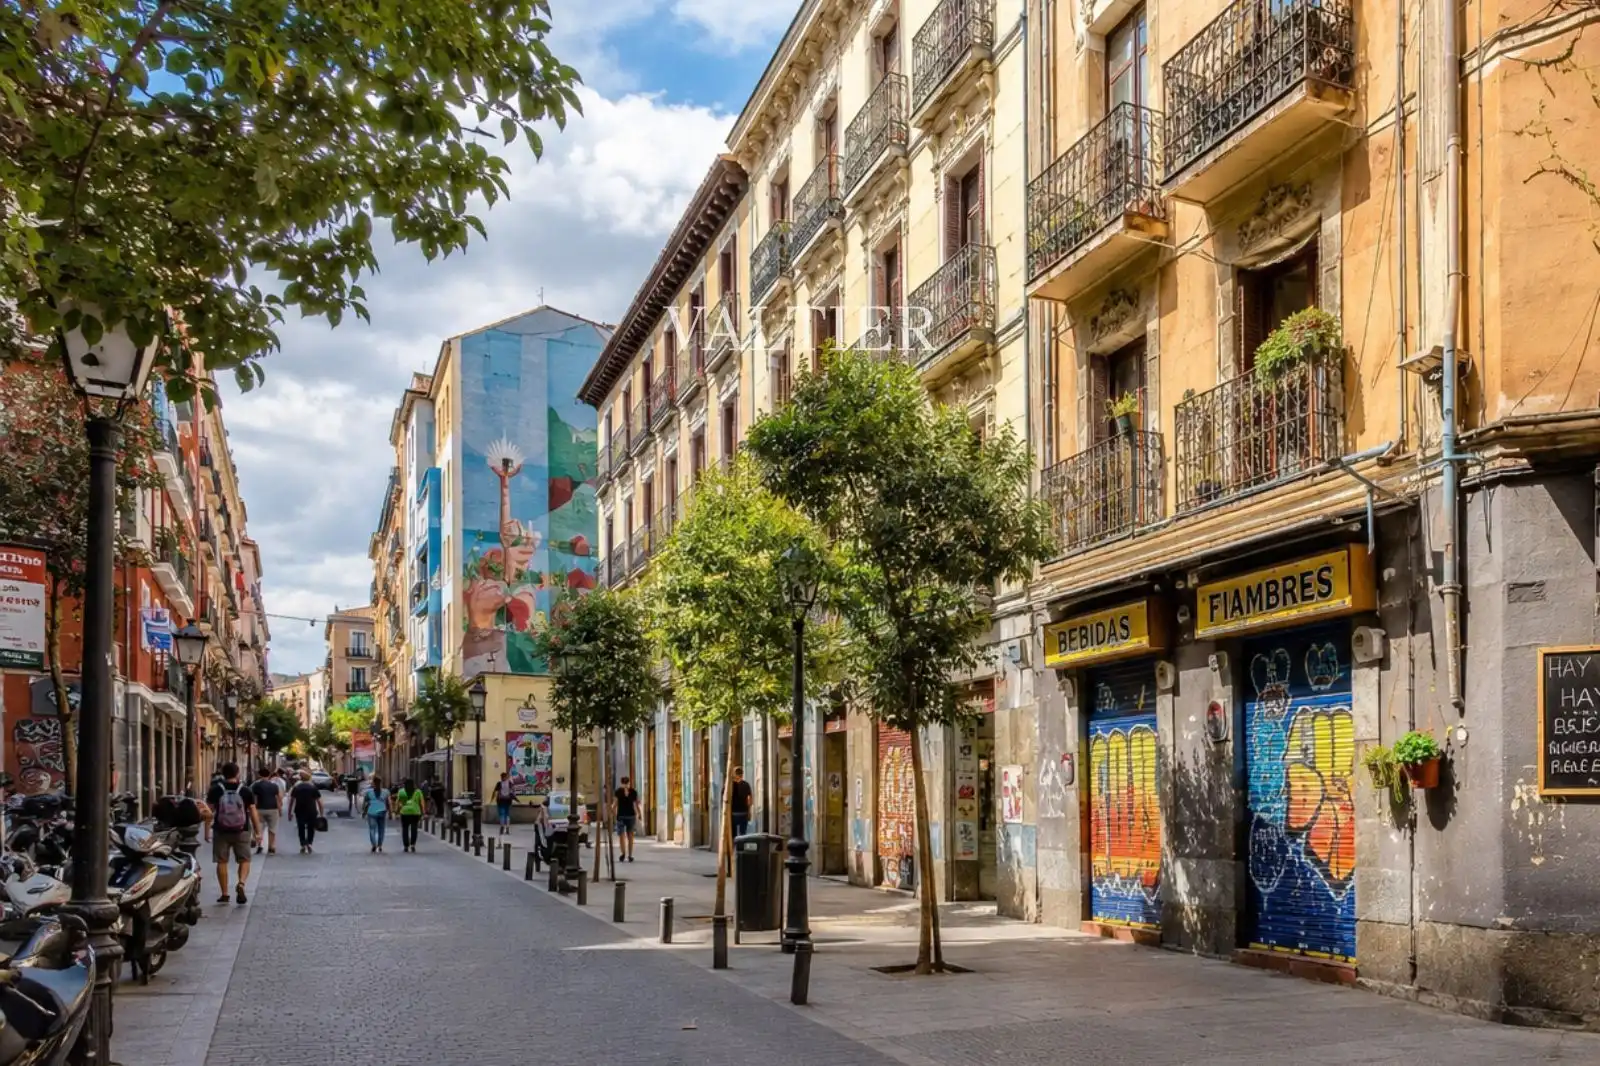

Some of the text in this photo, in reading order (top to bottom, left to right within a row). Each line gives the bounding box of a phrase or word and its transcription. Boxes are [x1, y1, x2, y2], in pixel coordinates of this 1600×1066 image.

[1208, 565, 1334, 623] FIAMBRES
[1058, 615, 1131, 654] BEBIDAS
[1549, 656, 1592, 678] HAY
